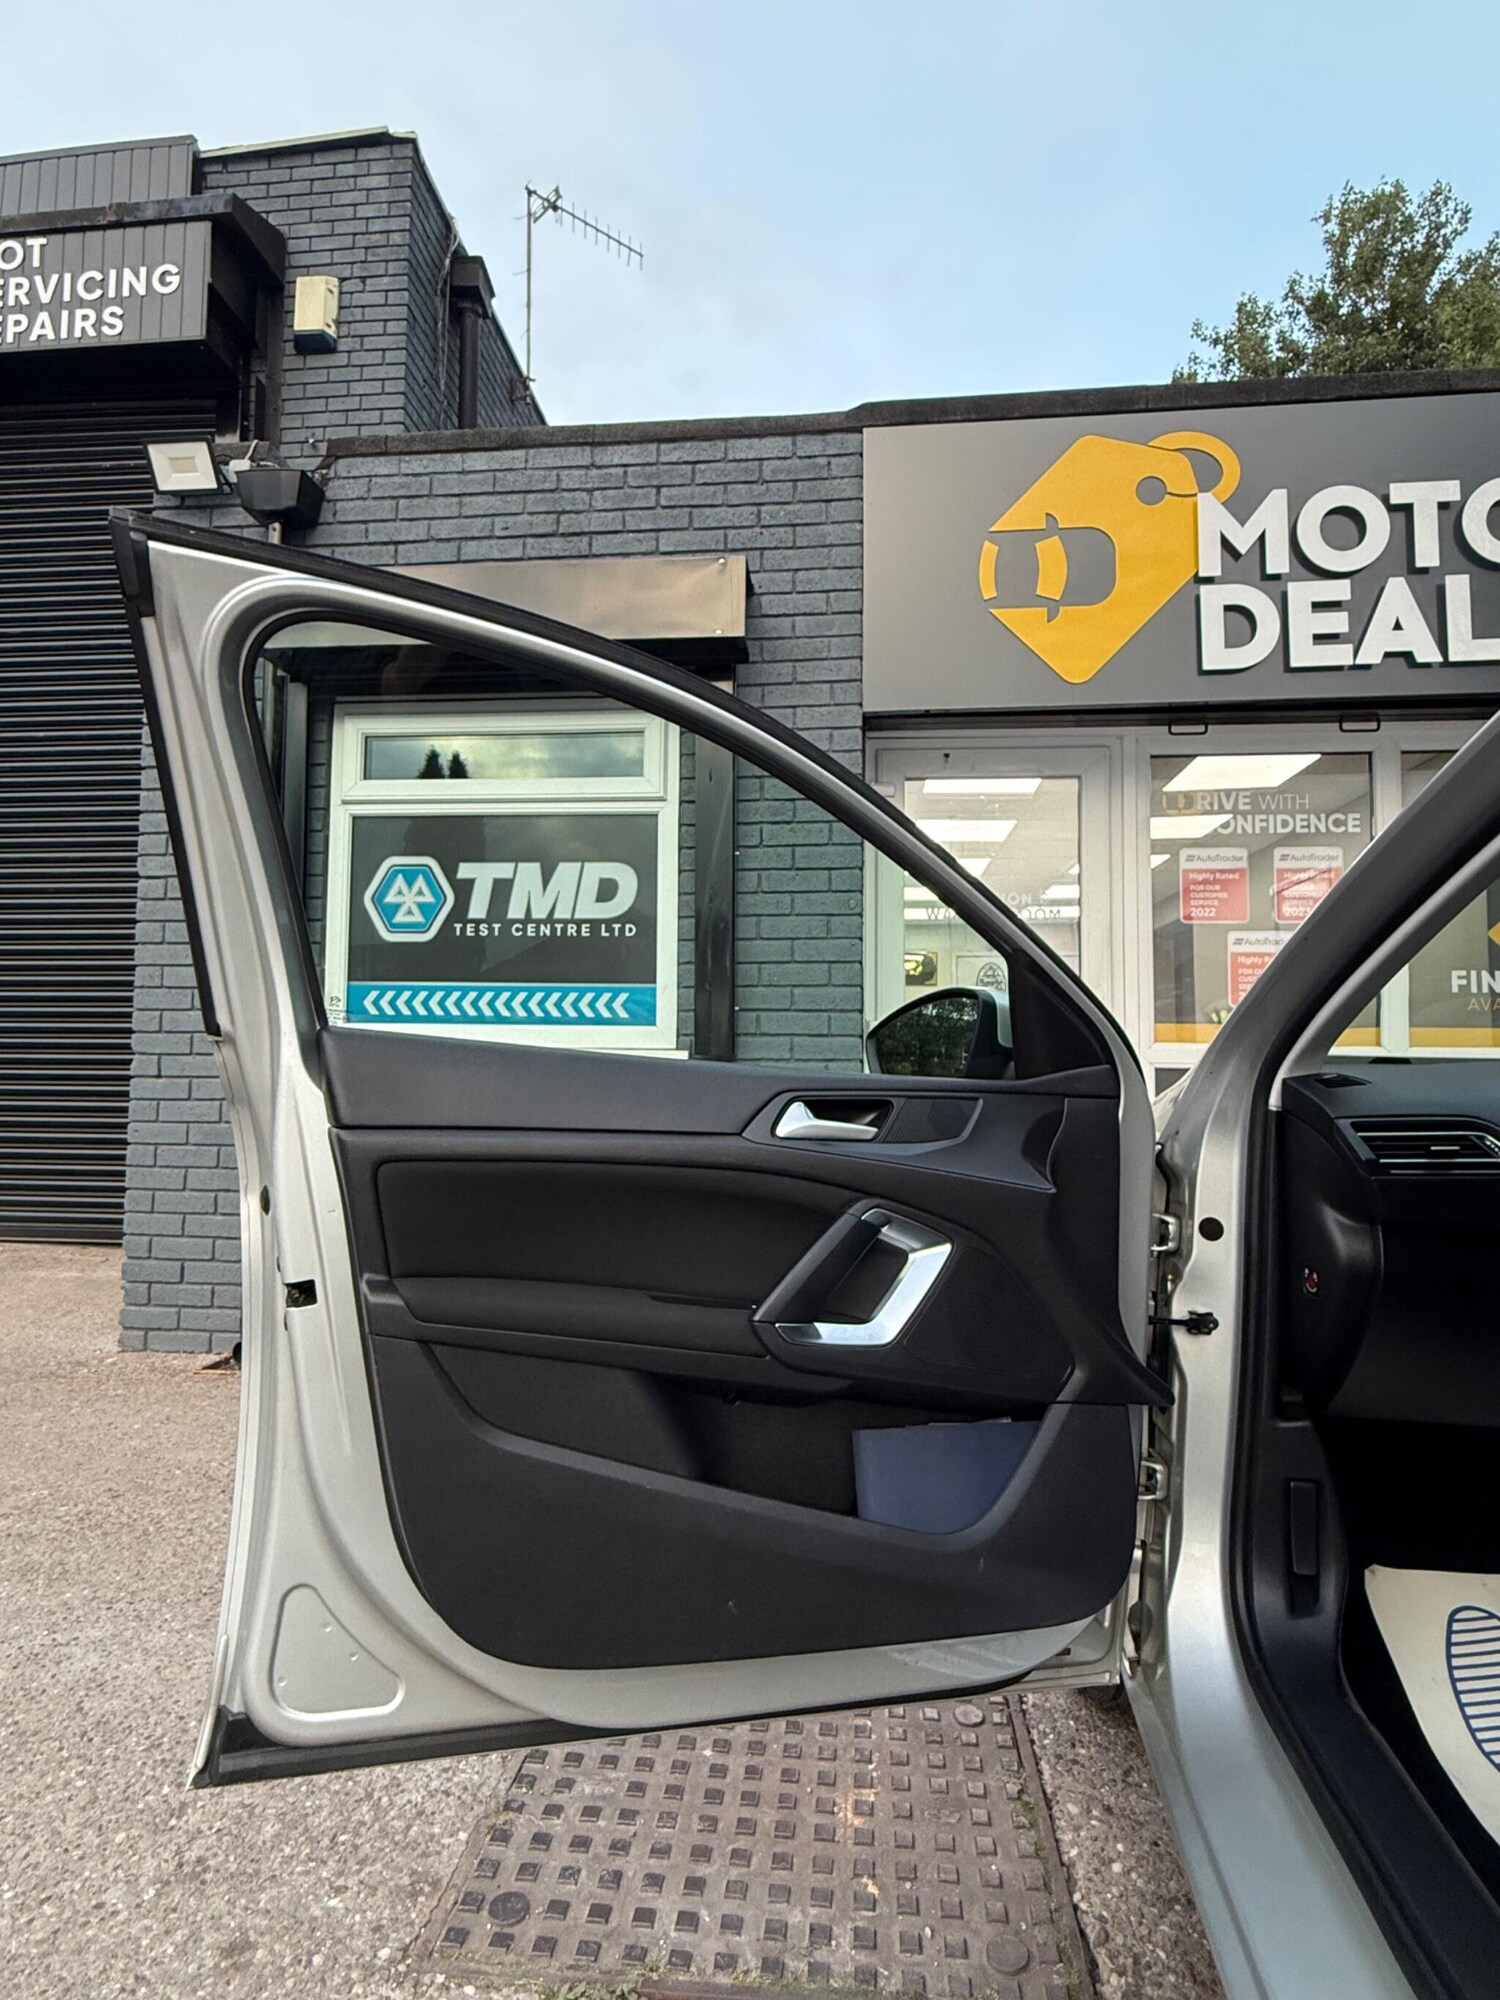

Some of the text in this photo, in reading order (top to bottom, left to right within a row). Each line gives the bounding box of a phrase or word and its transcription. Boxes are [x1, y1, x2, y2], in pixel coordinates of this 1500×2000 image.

[0, 263, 182, 307] RVICING
[0, 305, 125, 344] PAIRS
[1200, 574, 1500, 671] DEAL
[1258, 793, 1310, 810] WITH
[1215, 813, 1362, 835] ONFIDENCE
[1188, 872, 1214, 881] Highly
[456, 861, 639, 919] TMD
[1190, 907, 1217, 917] 2022
[453, 923, 638, 937] TEST CENTRE LTD
[1451, 970, 1500, 993] FIN
